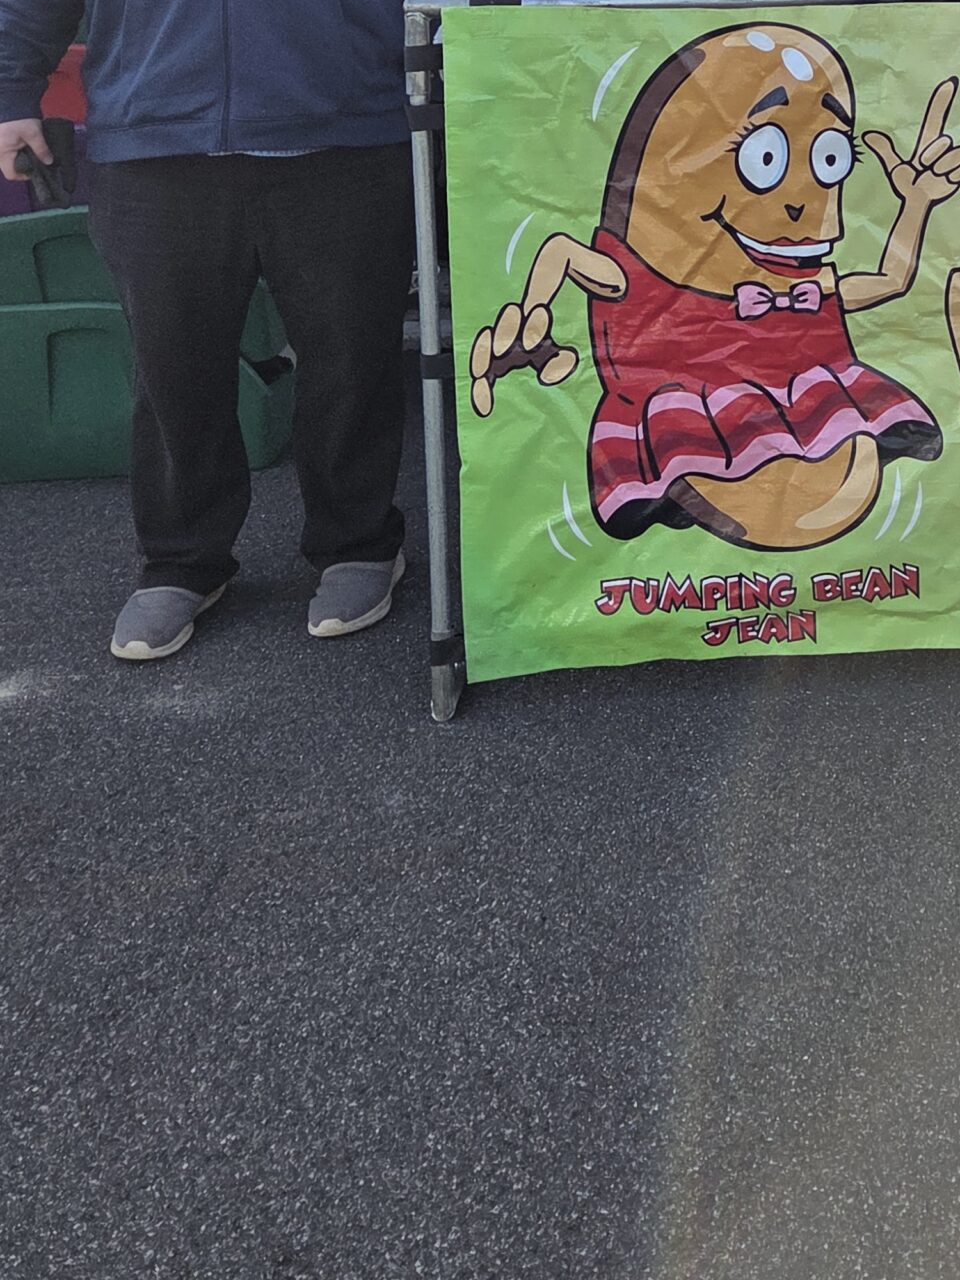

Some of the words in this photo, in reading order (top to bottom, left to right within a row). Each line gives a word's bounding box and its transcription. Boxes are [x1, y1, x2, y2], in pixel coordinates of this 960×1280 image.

[594, 571, 797, 616] JUMPING
[811, 563, 920, 604] BEAN
[701, 609, 817, 646] JEAN
